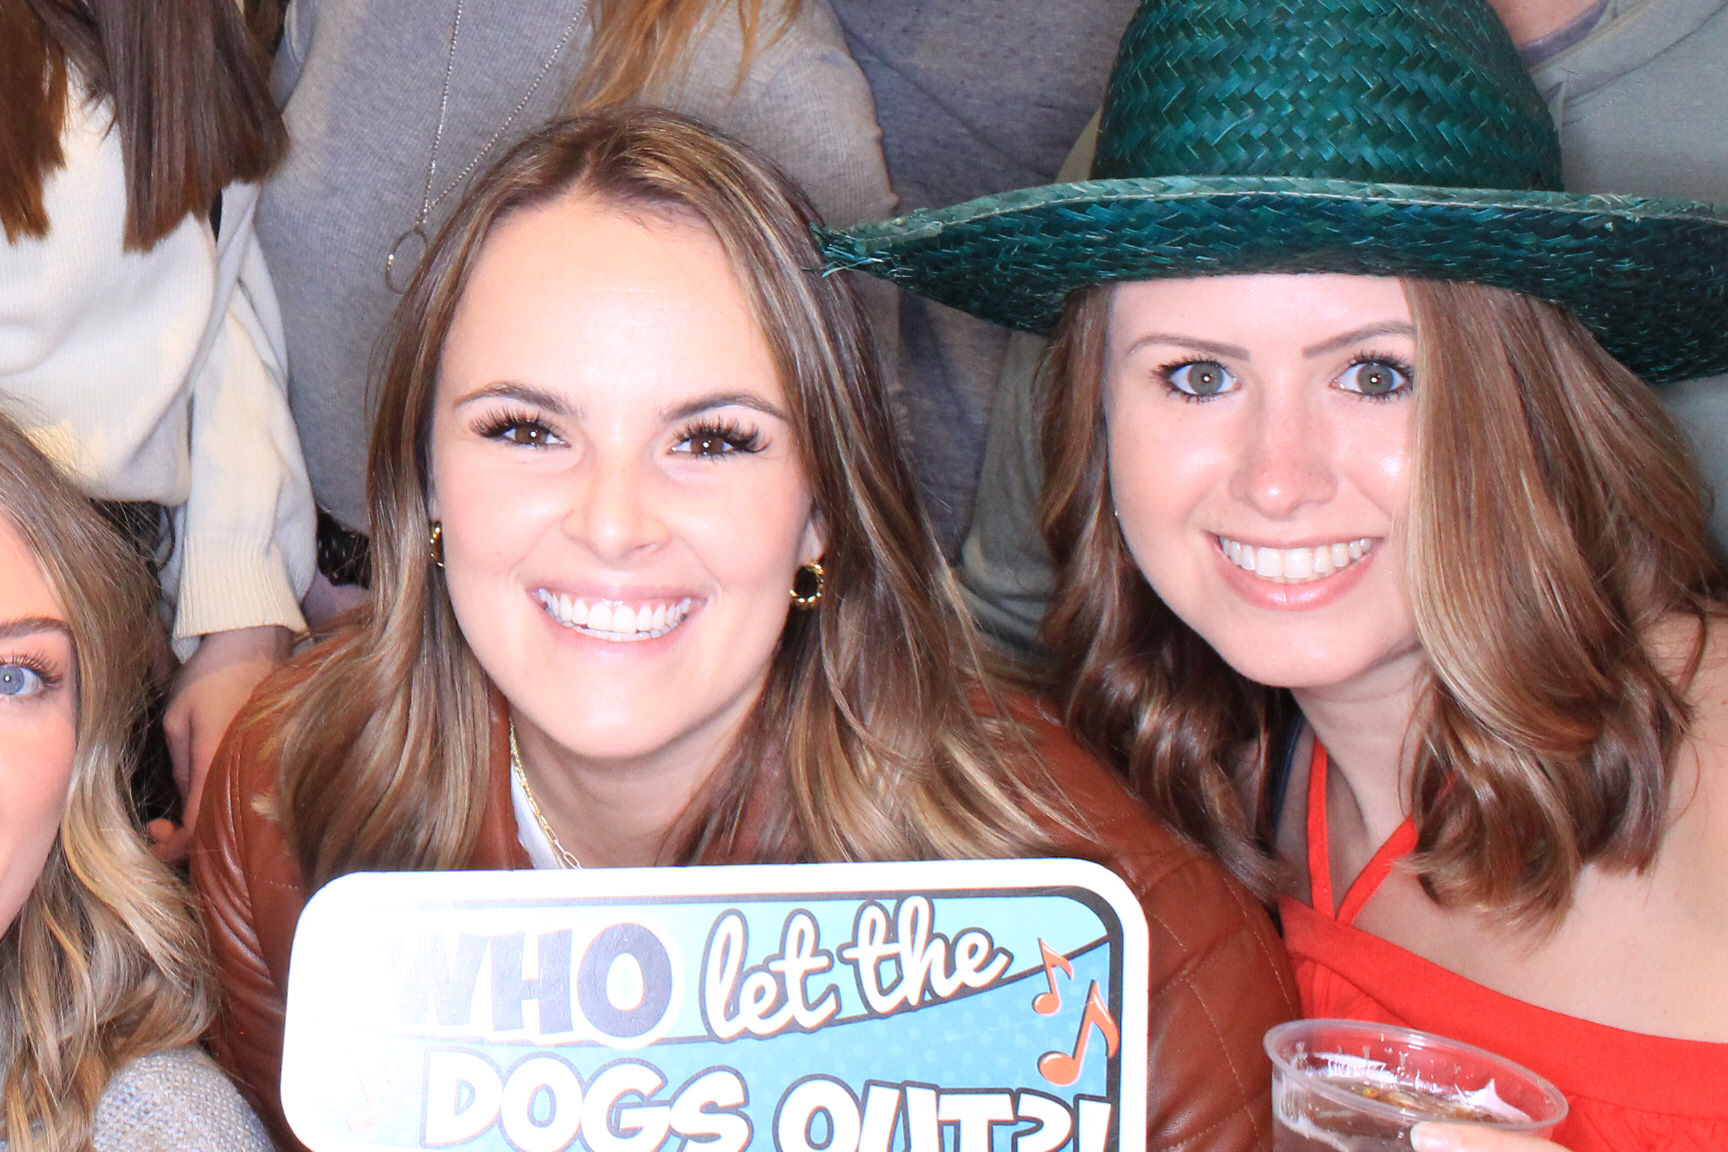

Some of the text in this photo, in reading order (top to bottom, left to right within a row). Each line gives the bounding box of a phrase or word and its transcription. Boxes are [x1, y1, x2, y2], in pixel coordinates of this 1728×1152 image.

[380, 896, 1013, 1041] WHO let the
[422, 1051, 753, 1152] DOGS
